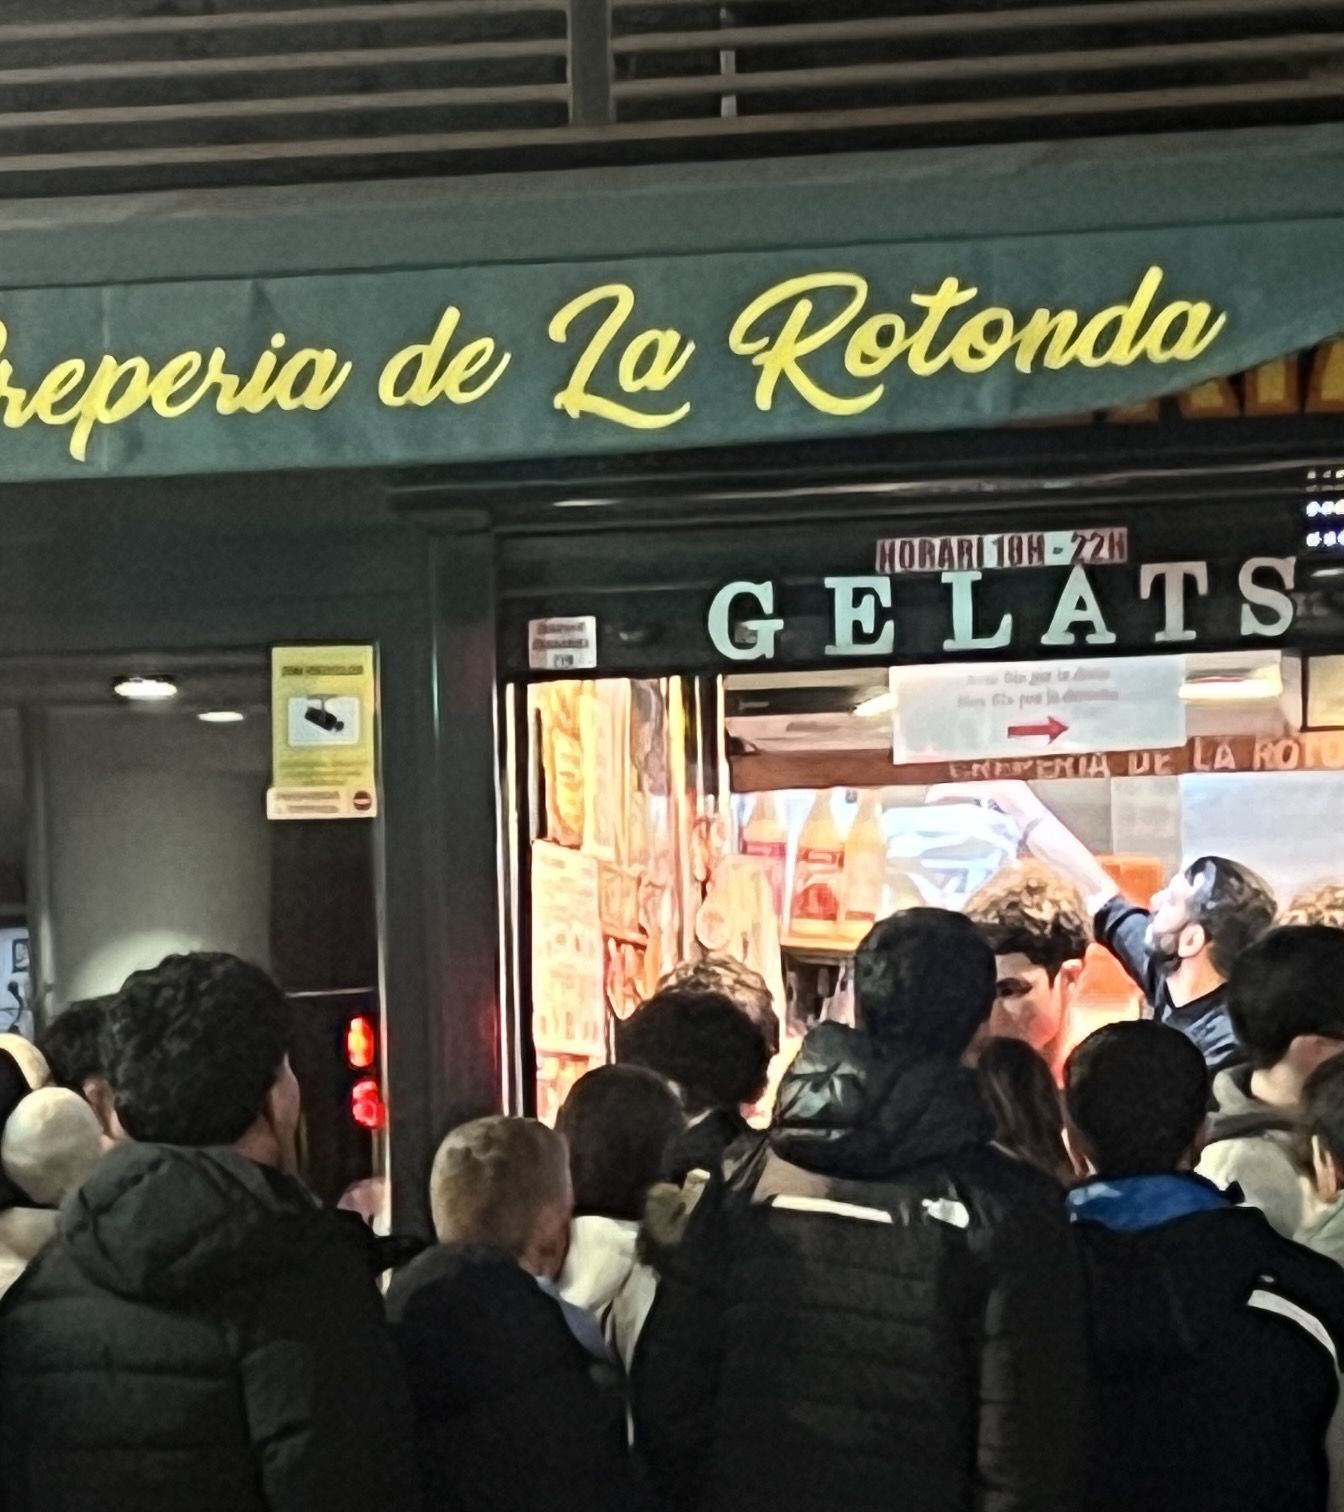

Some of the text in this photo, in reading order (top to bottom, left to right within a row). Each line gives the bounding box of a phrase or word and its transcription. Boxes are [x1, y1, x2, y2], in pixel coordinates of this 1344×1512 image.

[379, 306, 511, 407] de
[549, 283, 694, 429] La
[728, 265, 1226, 415] Rotonda
[879, 535, 985, 573] HORARI
[1070, 530, 1126, 565] 22H
[707, 557, 1296, 661] GELATS
[1193, 737, 1236, 770] LA
